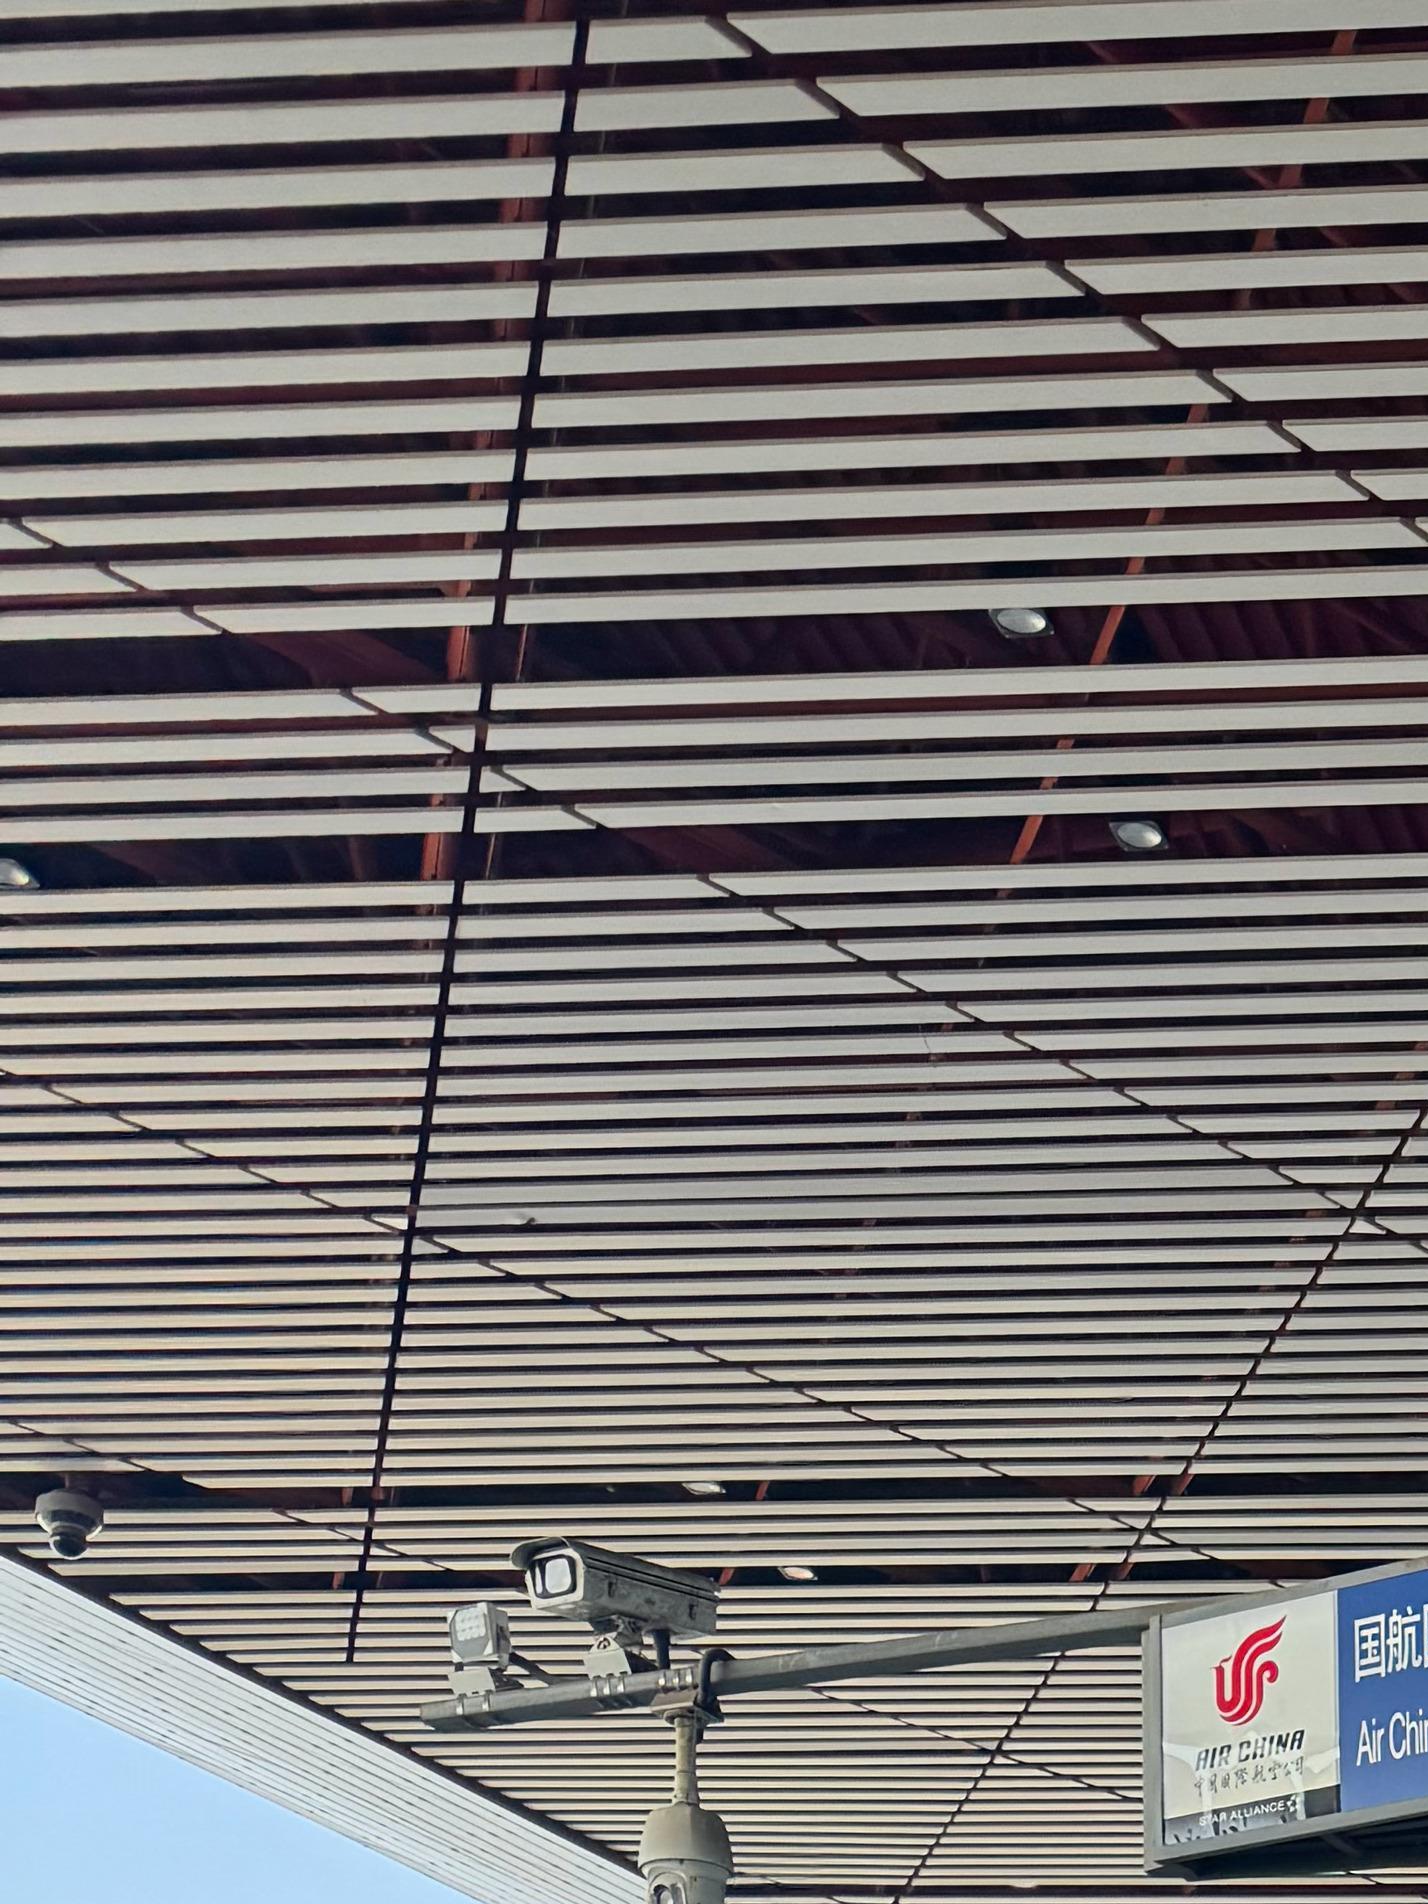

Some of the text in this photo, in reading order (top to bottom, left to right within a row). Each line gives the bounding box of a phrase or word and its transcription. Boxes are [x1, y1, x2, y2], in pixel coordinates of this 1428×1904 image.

[1195, 1729, 1305, 1771] AIR CHINA
[1356, 1719, 1385, 1766] Air
[1199, 1799, 1287, 1826] STAR ALLIANCE
